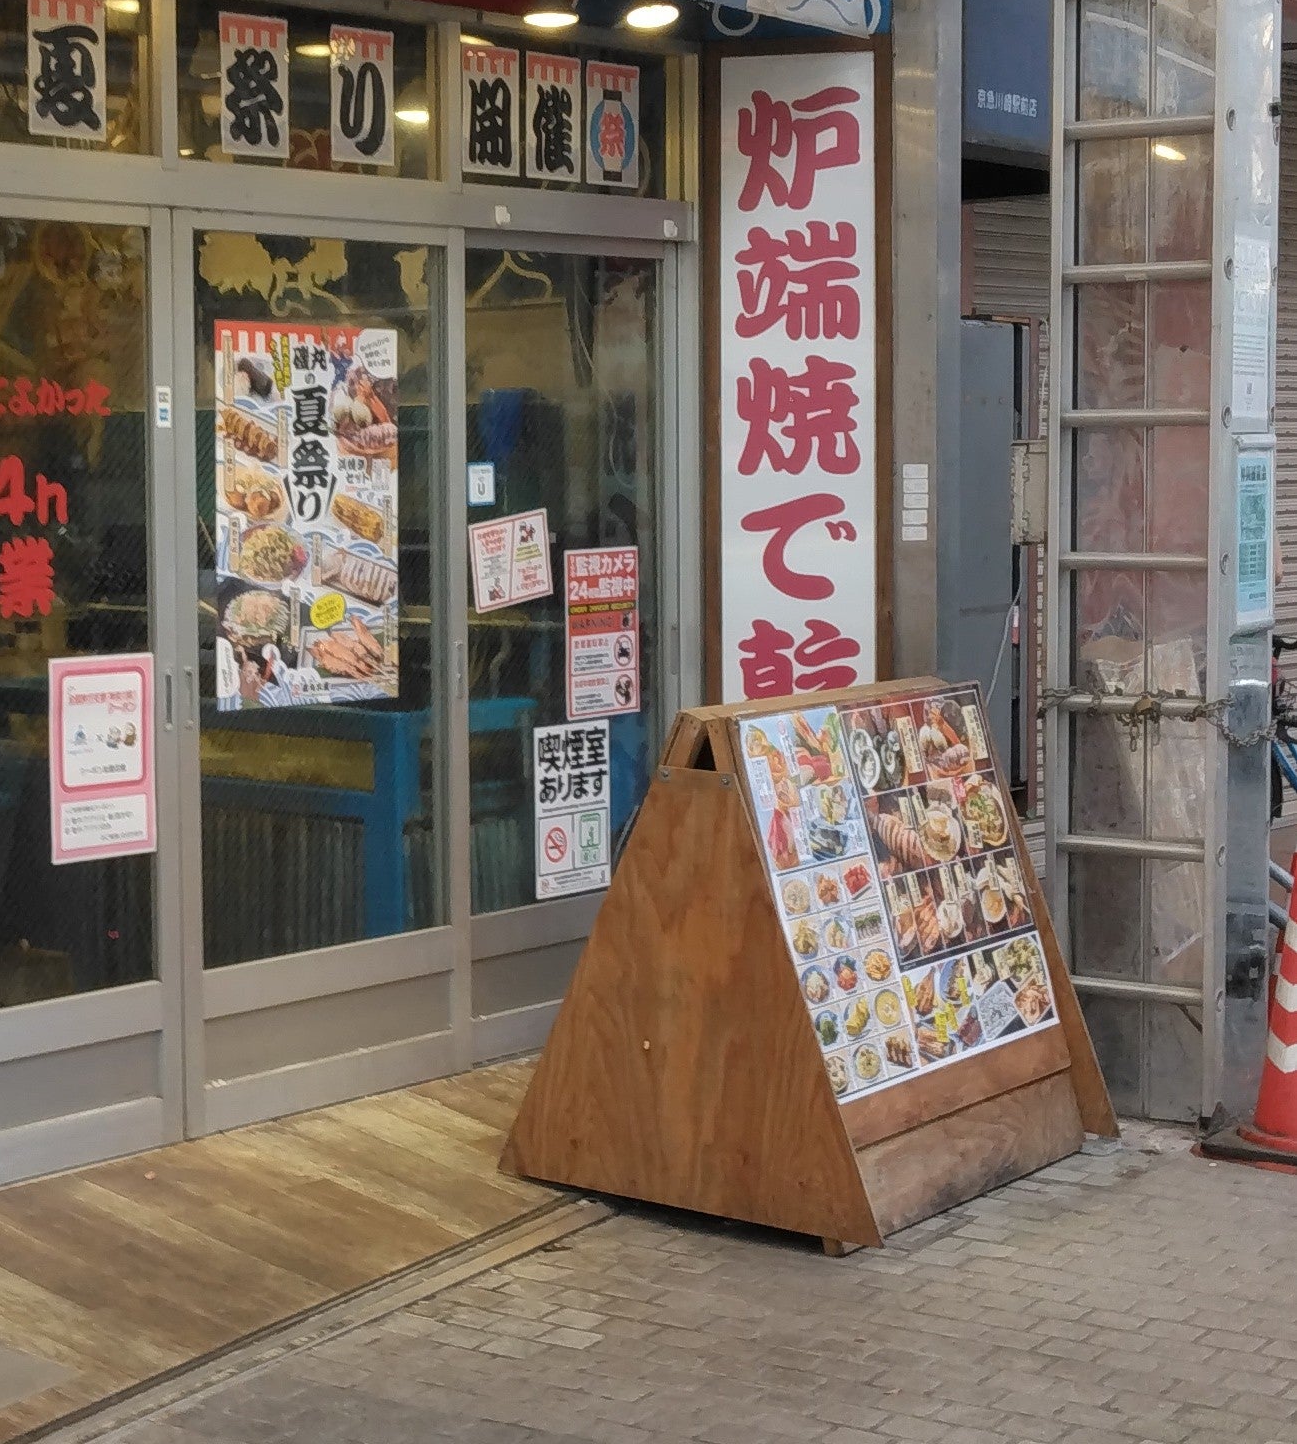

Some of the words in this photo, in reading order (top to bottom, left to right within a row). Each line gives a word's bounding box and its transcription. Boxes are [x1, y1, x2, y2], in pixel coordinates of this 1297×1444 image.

[292, 385, 329, 522] 夏祭り
[538, 726, 607, 773] 喫煙室
[539, 768, 607, 804] あります
